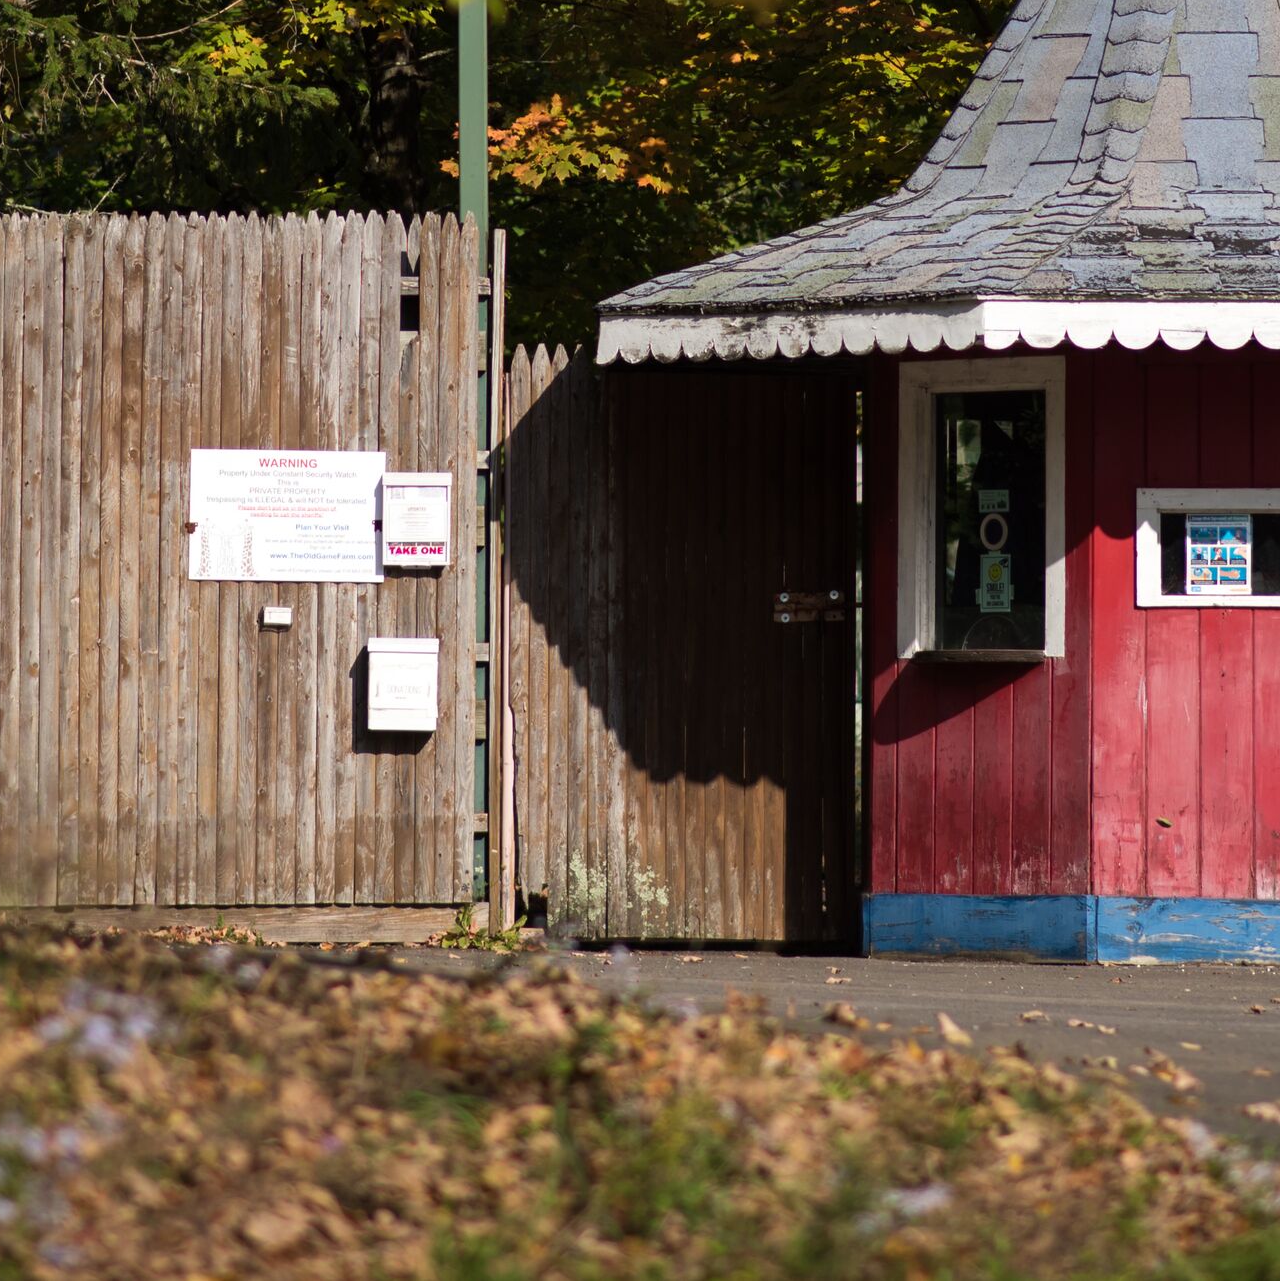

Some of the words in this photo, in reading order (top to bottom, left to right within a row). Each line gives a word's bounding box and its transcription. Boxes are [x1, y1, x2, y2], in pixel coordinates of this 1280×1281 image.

[258, 457, 319, 469] WARNING
[219, 469, 249, 479] Property
[250, 470, 271, 478] Under
[272, 470, 304, 479] Constant
[305, 470, 333, 480] Security
[335, 471, 358, 479] Watch
[277, 478, 292, 487] This
[249, 487, 282, 495] PRIVATE
[283, 487, 326, 496] PROPERTY
[206, 496, 246, 505] trespassing
[255, 496, 285, 504] ILLEGAL
[287, 496, 293, 504] &
[308, 496, 324, 505] NOT
[295, 523, 312, 531] Plan
[314, 523, 332, 531] Your
[333, 524, 350, 532] Visit
[388, 546, 418, 556] TAKE
[420, 546, 445, 556] ONE
[269, 552, 375, 561] www.TheOldGameFarm.com
